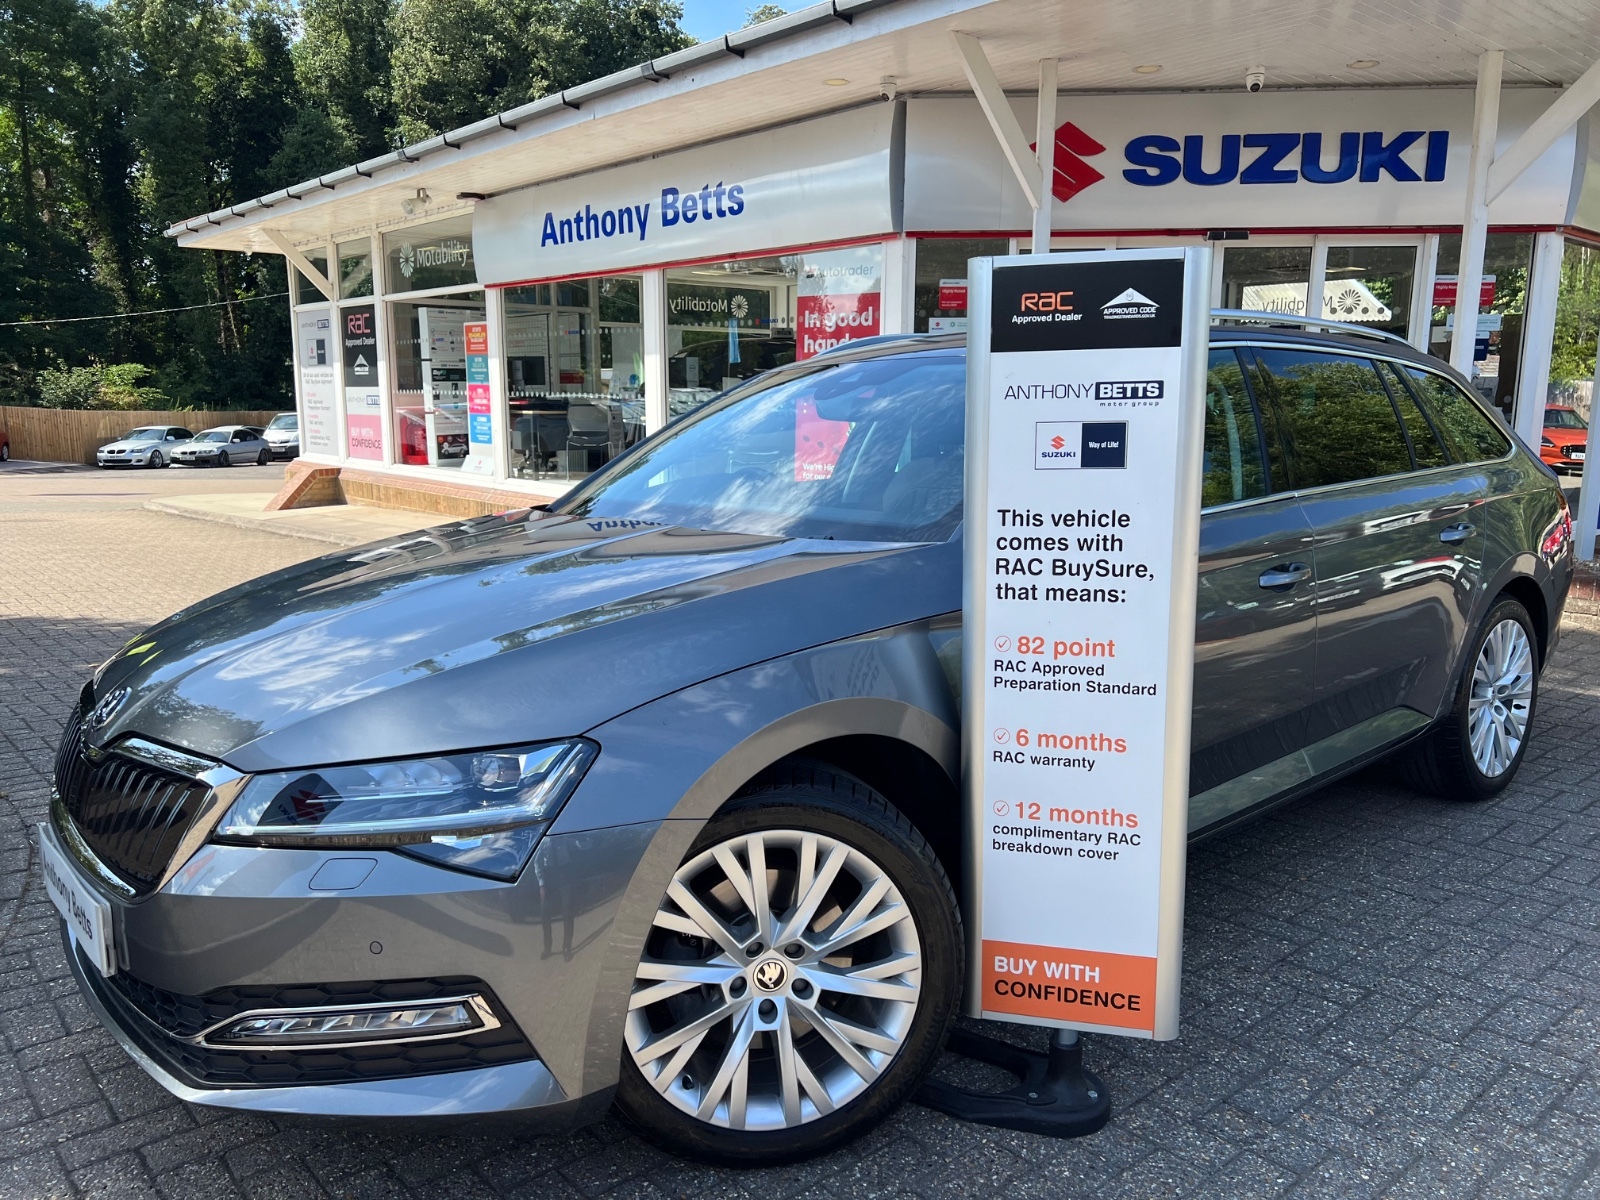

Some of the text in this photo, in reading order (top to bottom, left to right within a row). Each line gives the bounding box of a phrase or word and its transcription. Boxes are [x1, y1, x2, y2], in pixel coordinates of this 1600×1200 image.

[1123, 130, 1450, 187] SUZUKI
[540, 180, 745, 248] Anthony Betts
[416, 240, 469, 268] Motability
[804, 306, 873, 333] In good
[1011, 312, 1083, 325] Approved Dealer
[1103, 306, 1157, 315] APPROVED CODE
[345, 337, 376, 348] Approved Dealer
[803, 333, 858, 353] hand
[1004, 382, 1160, 400] ANTHONY BETTS
[351, 438, 382, 450] CONFIDENCE
[1088, 441, 1100, 449] Way
[996, 509, 1131, 528] This vehicle
[996, 533, 1124, 552] comes with
[995, 557, 1154, 582] RAC BuySure,
[995, 582, 1127, 604] that means:
[1016, 635, 1116, 661] 82 point
[993, 659, 1105, 677] RAC Approved
[993, 676, 1157, 696] Preparation Standard
[1015, 728, 1128, 753] 6 months
[993, 750, 1096, 772] RAC warranty
[1015, 801, 1139, 829] 12 months
[992, 825, 1142, 847] complimentary RAC
[992, 838, 1120, 861] breakdown cover
[43, 850, 94, 940] Anthony Betts
[994, 955, 1100, 984] BUY WITH
[994, 979, 1141, 1012] CONFIDENCE
